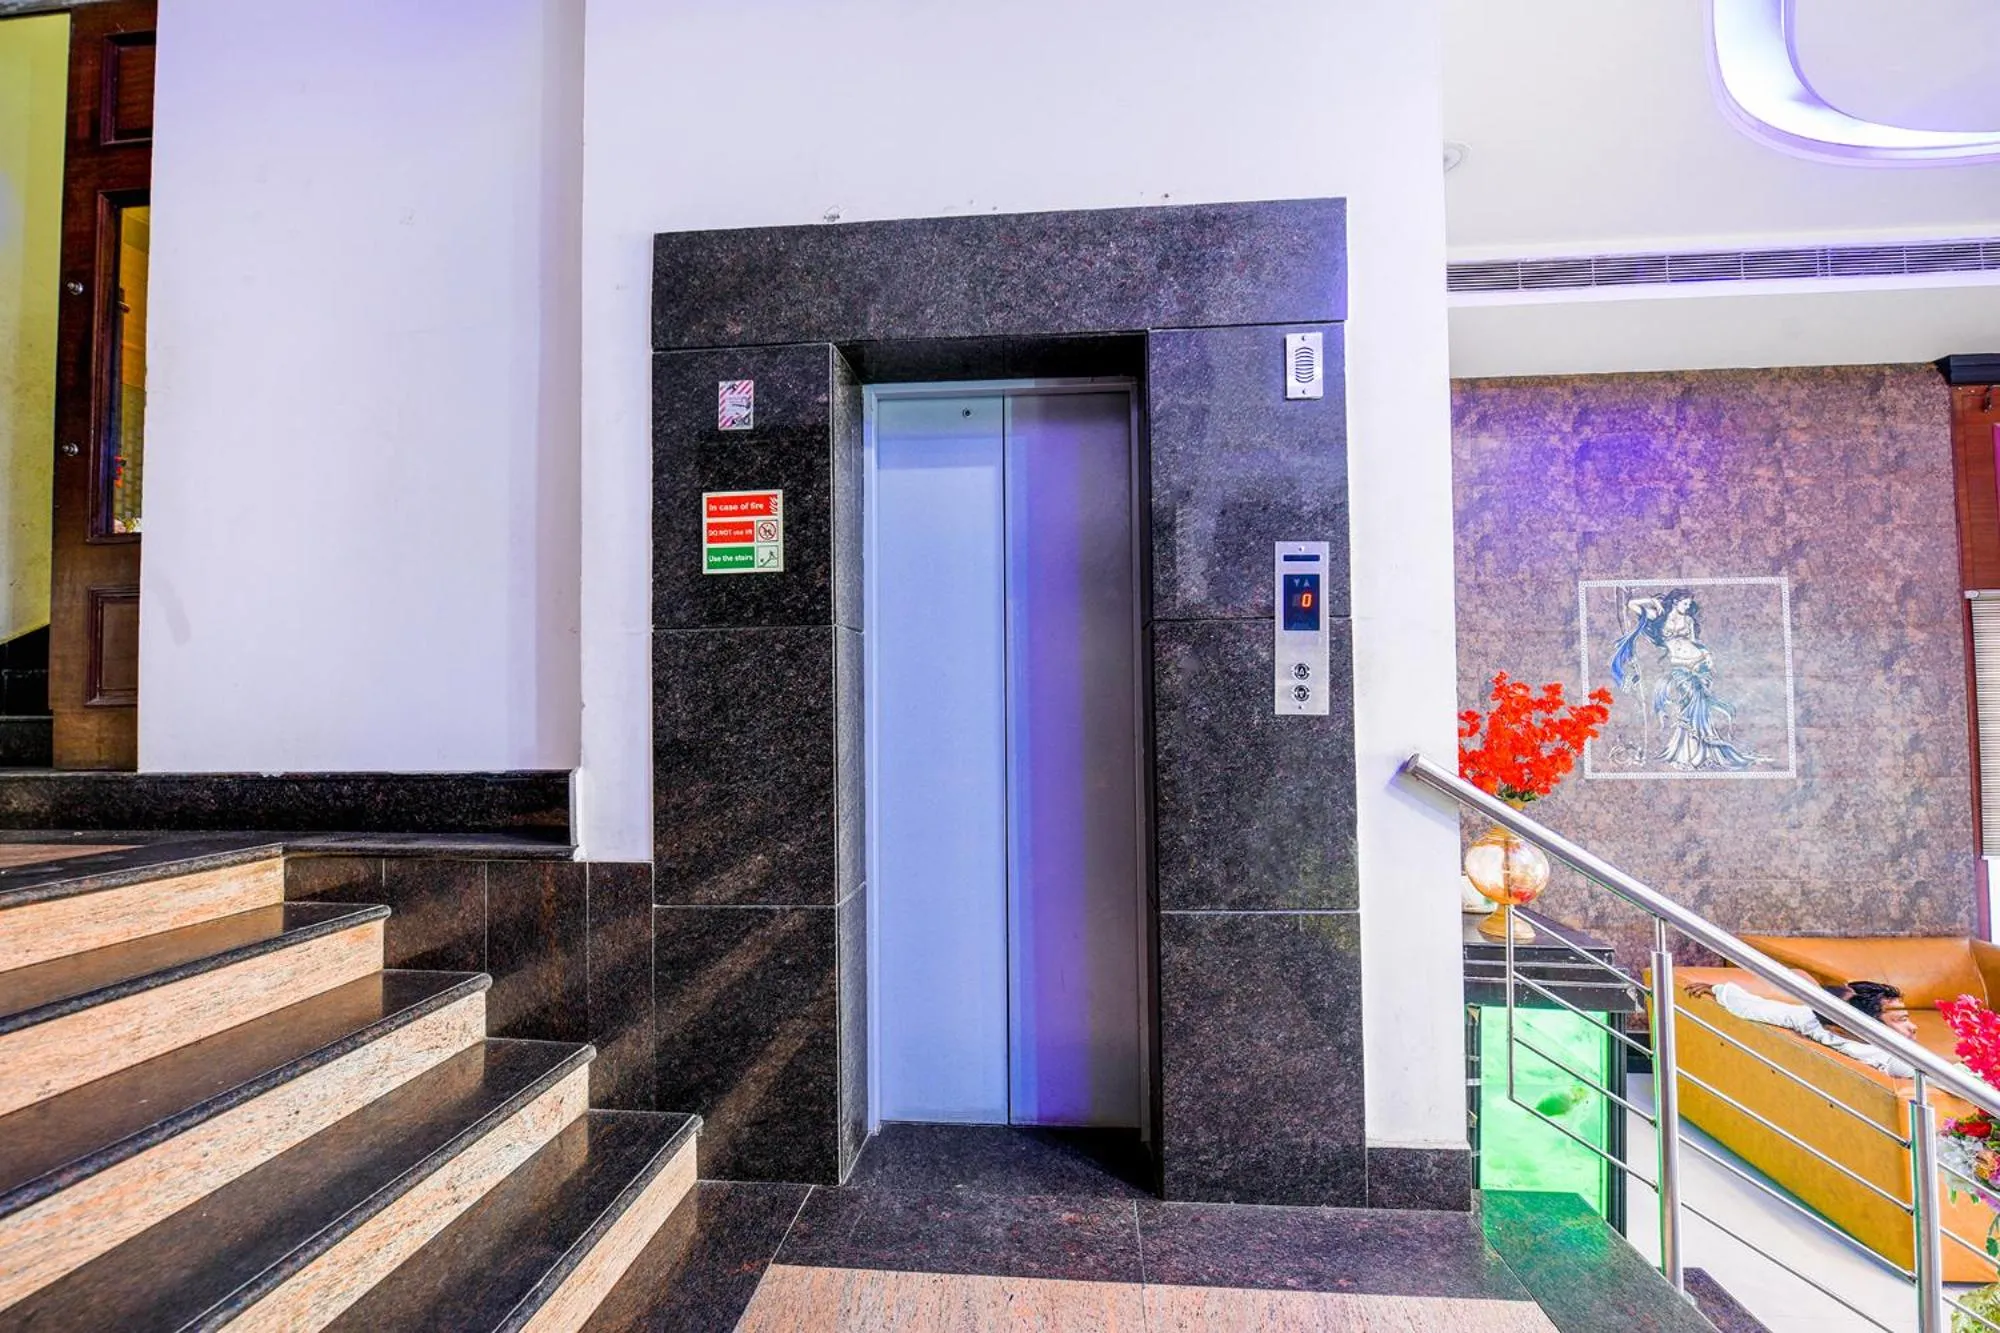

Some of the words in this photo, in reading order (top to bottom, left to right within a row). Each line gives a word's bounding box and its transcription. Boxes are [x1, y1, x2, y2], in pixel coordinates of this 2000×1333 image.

[740, 502, 749, 510] of
[750, 502, 764, 510] fire
[1302, 593, 1312, 608] 0
